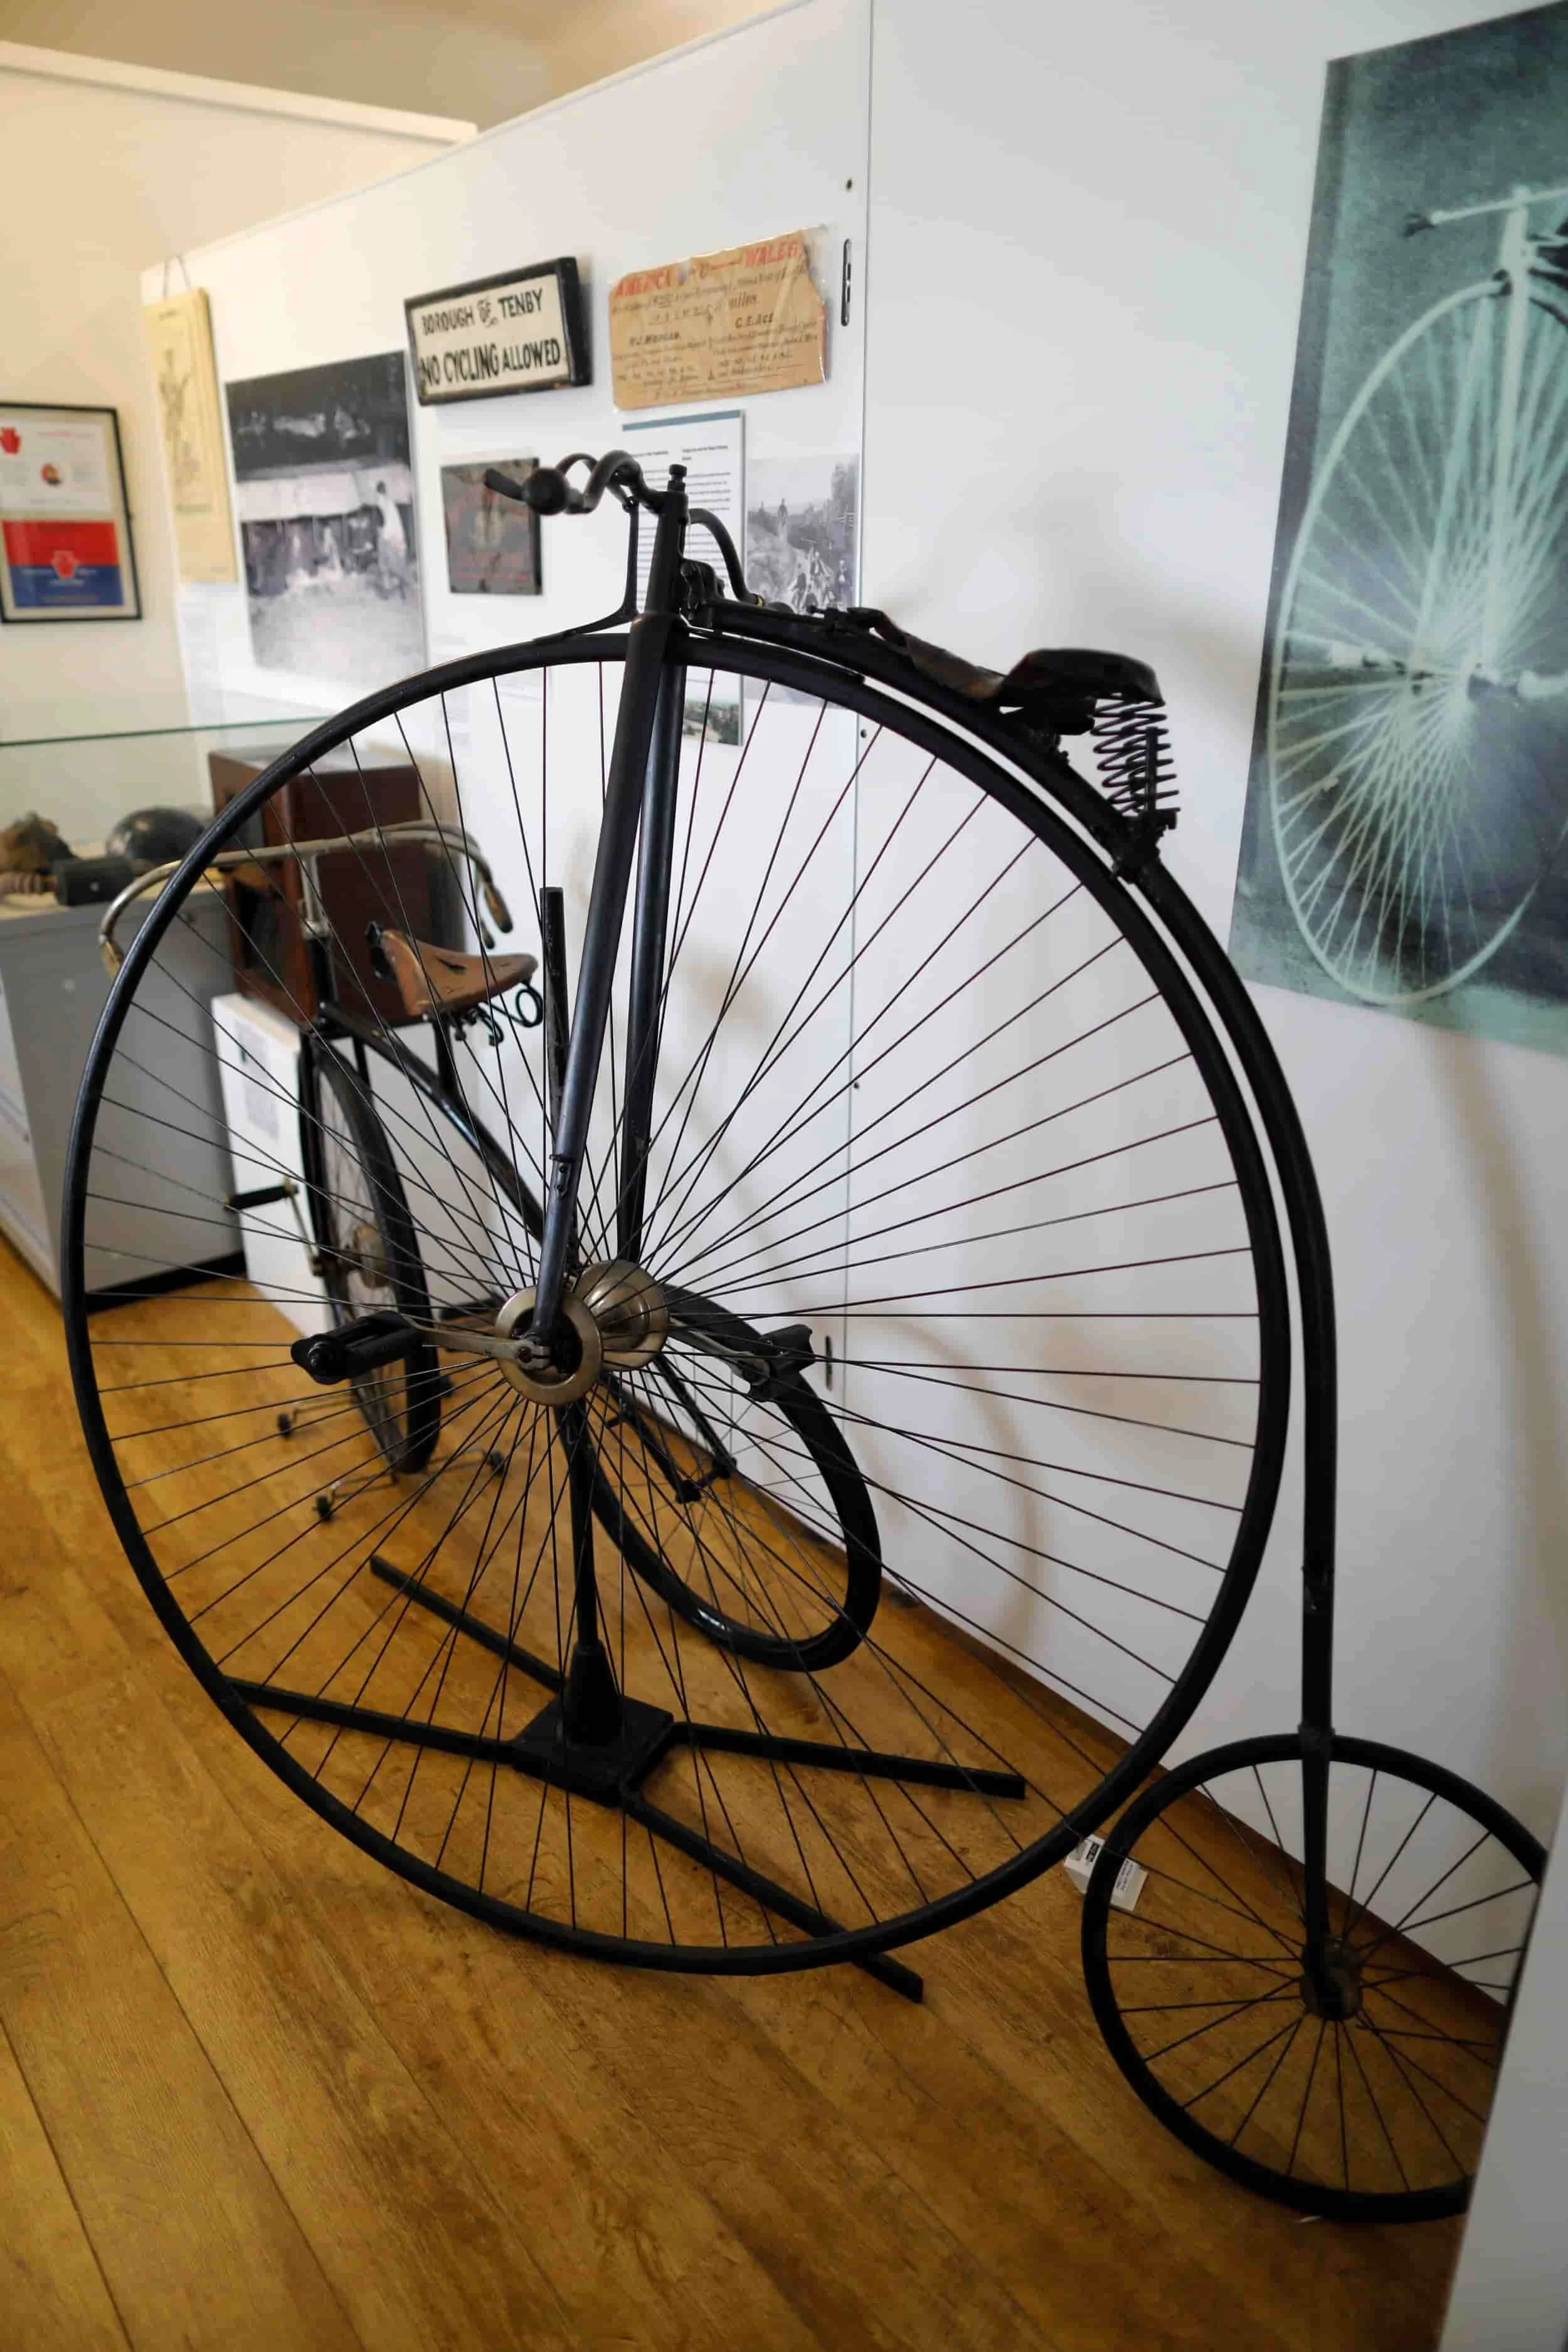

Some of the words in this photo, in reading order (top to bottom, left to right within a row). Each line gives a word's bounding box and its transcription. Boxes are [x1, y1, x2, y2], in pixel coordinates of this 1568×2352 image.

[421, 305, 475, 336] BOROUGH
[497, 289, 543, 320] TENBY
[421, 354, 441, 386] NO
[443, 343, 500, 381] CYCLING
[503, 338, 560, 371] ALLOWED
